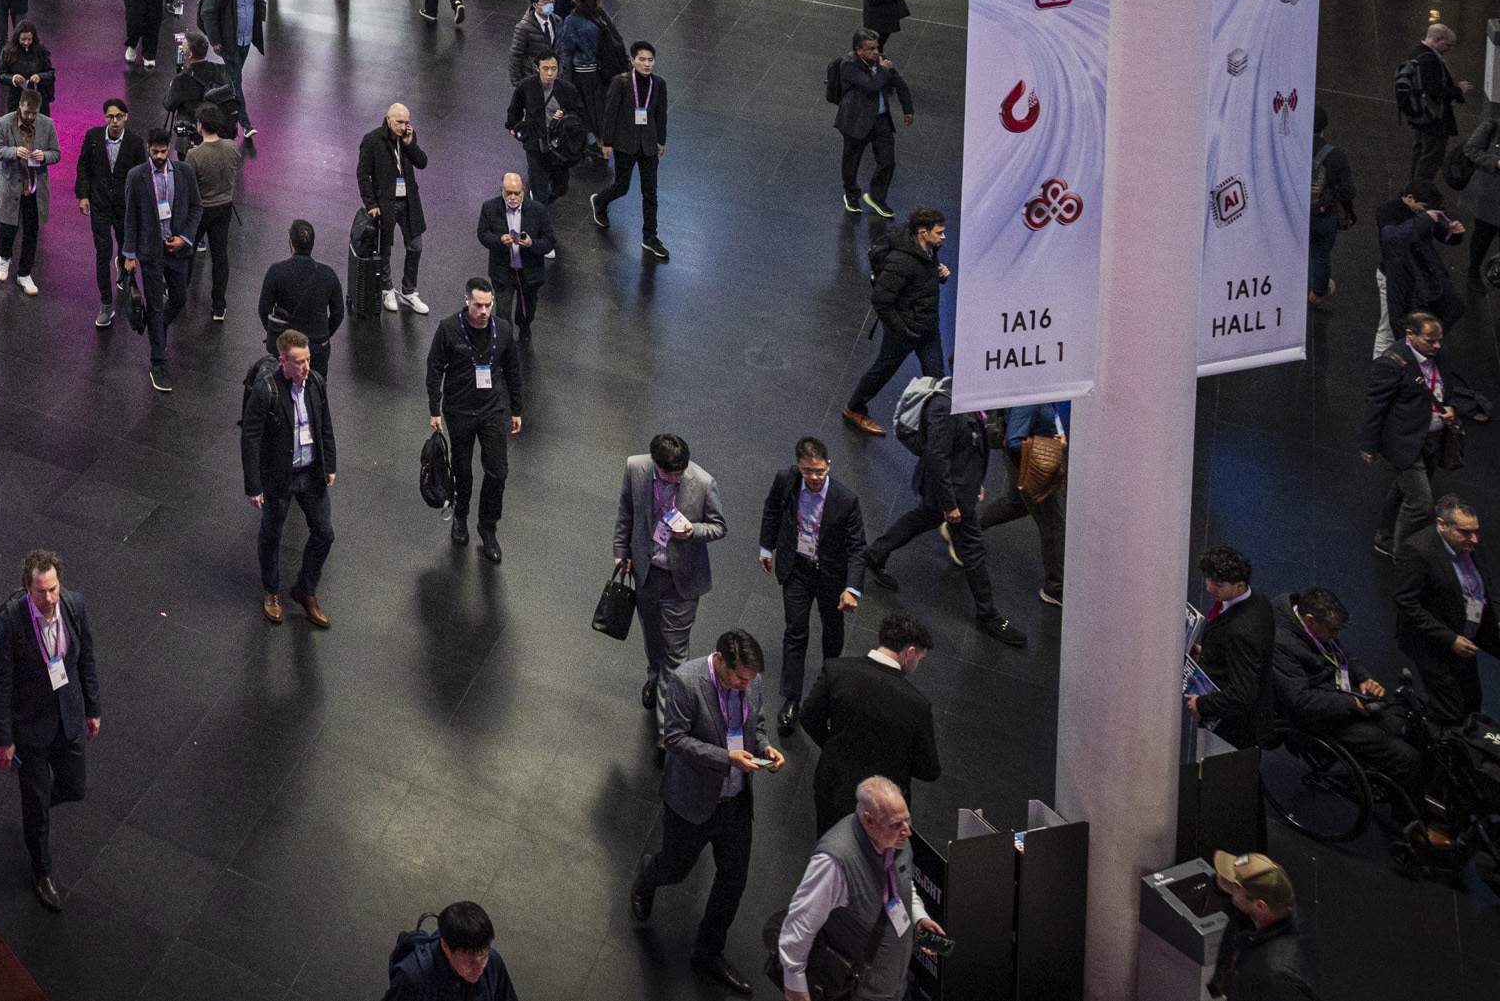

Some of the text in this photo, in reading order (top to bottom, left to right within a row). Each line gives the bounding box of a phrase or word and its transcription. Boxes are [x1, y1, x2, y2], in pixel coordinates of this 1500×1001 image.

[1226, 276, 1273, 301] 1A16
[1001, 308, 1053, 333] 1A16
[1212, 307, 1283, 338] HALL 1
[985, 341, 1065, 371] HALL 1
